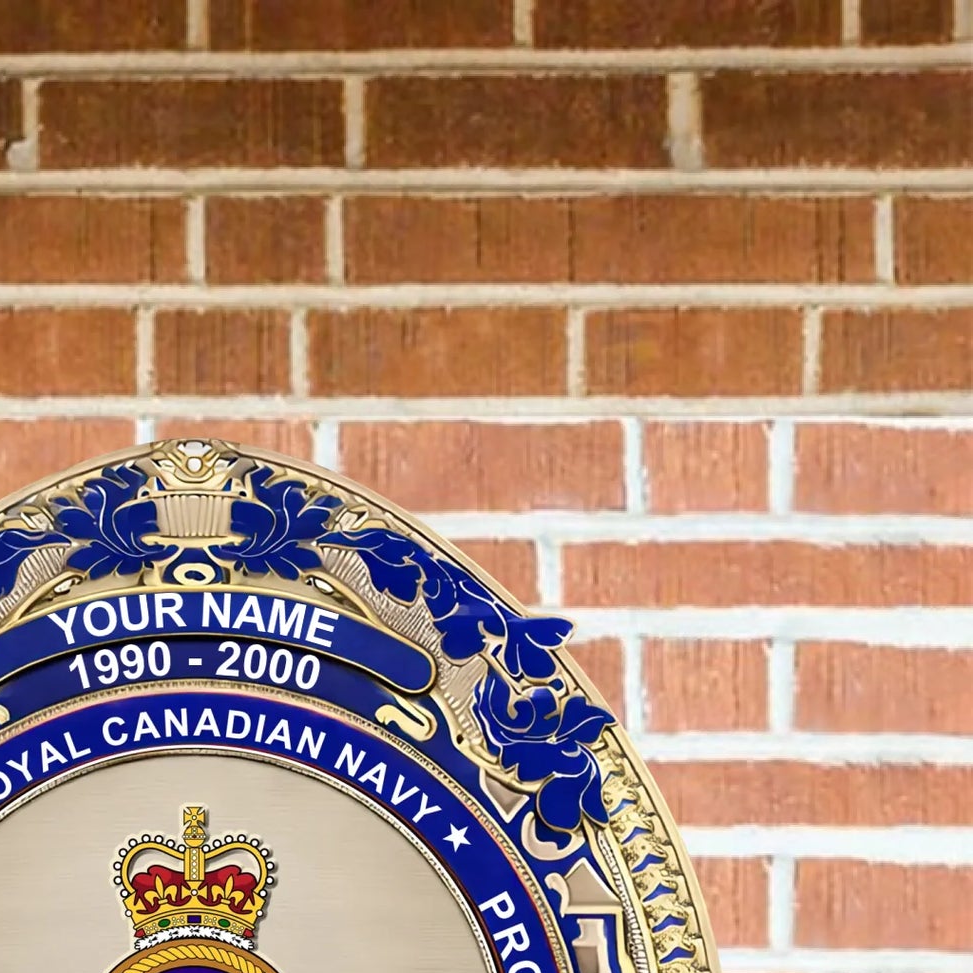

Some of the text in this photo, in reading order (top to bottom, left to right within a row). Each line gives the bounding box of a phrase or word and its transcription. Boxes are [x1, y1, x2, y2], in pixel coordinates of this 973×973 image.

[47, 591, 340, 648] YOUR NAME
[68, 641, 321, 690] 1990 - 2000
[102, 708, 327, 760] CANADIAN
[333, 743, 442, 824] NAVY
